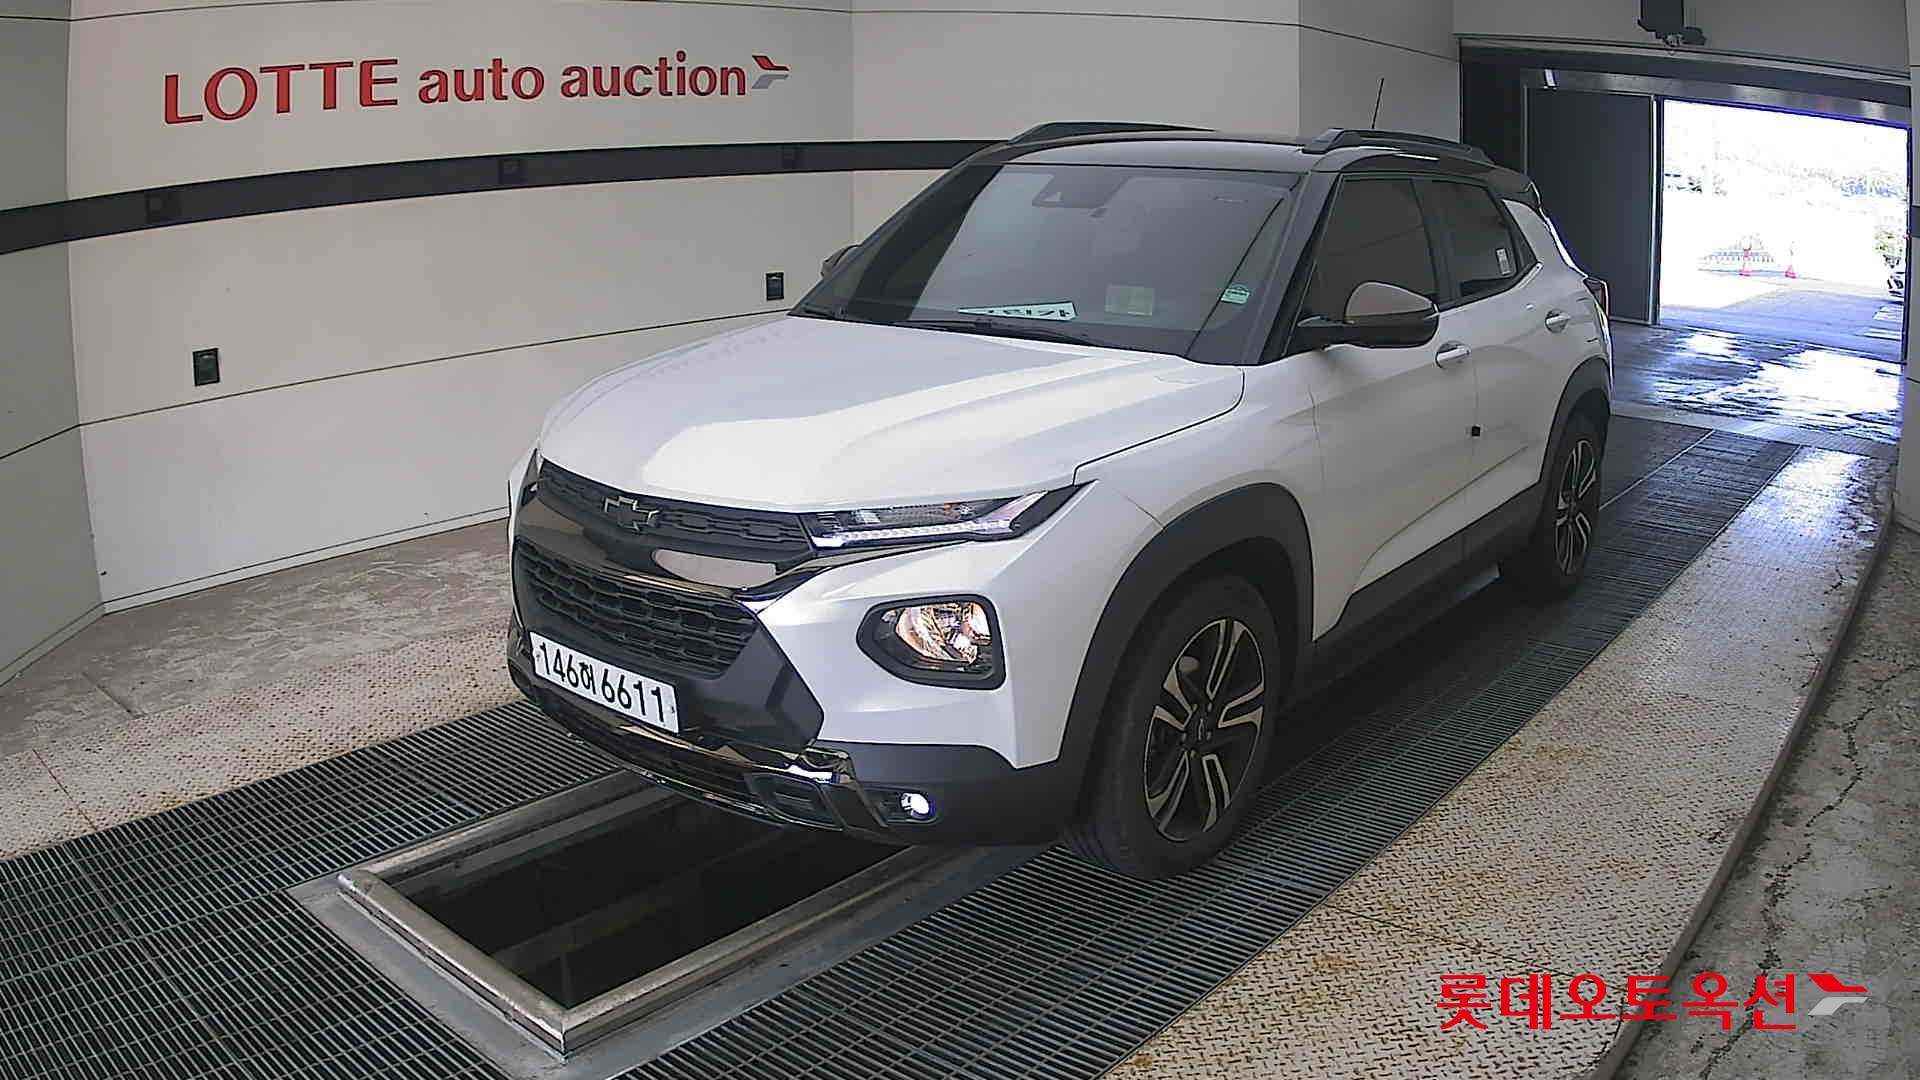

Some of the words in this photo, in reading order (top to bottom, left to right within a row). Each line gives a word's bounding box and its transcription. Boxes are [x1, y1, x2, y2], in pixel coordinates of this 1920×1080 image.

[164, 59, 399, 125] LOTTE
[418, 58, 544, 104] auto
[561, 51, 747, 98] auction
